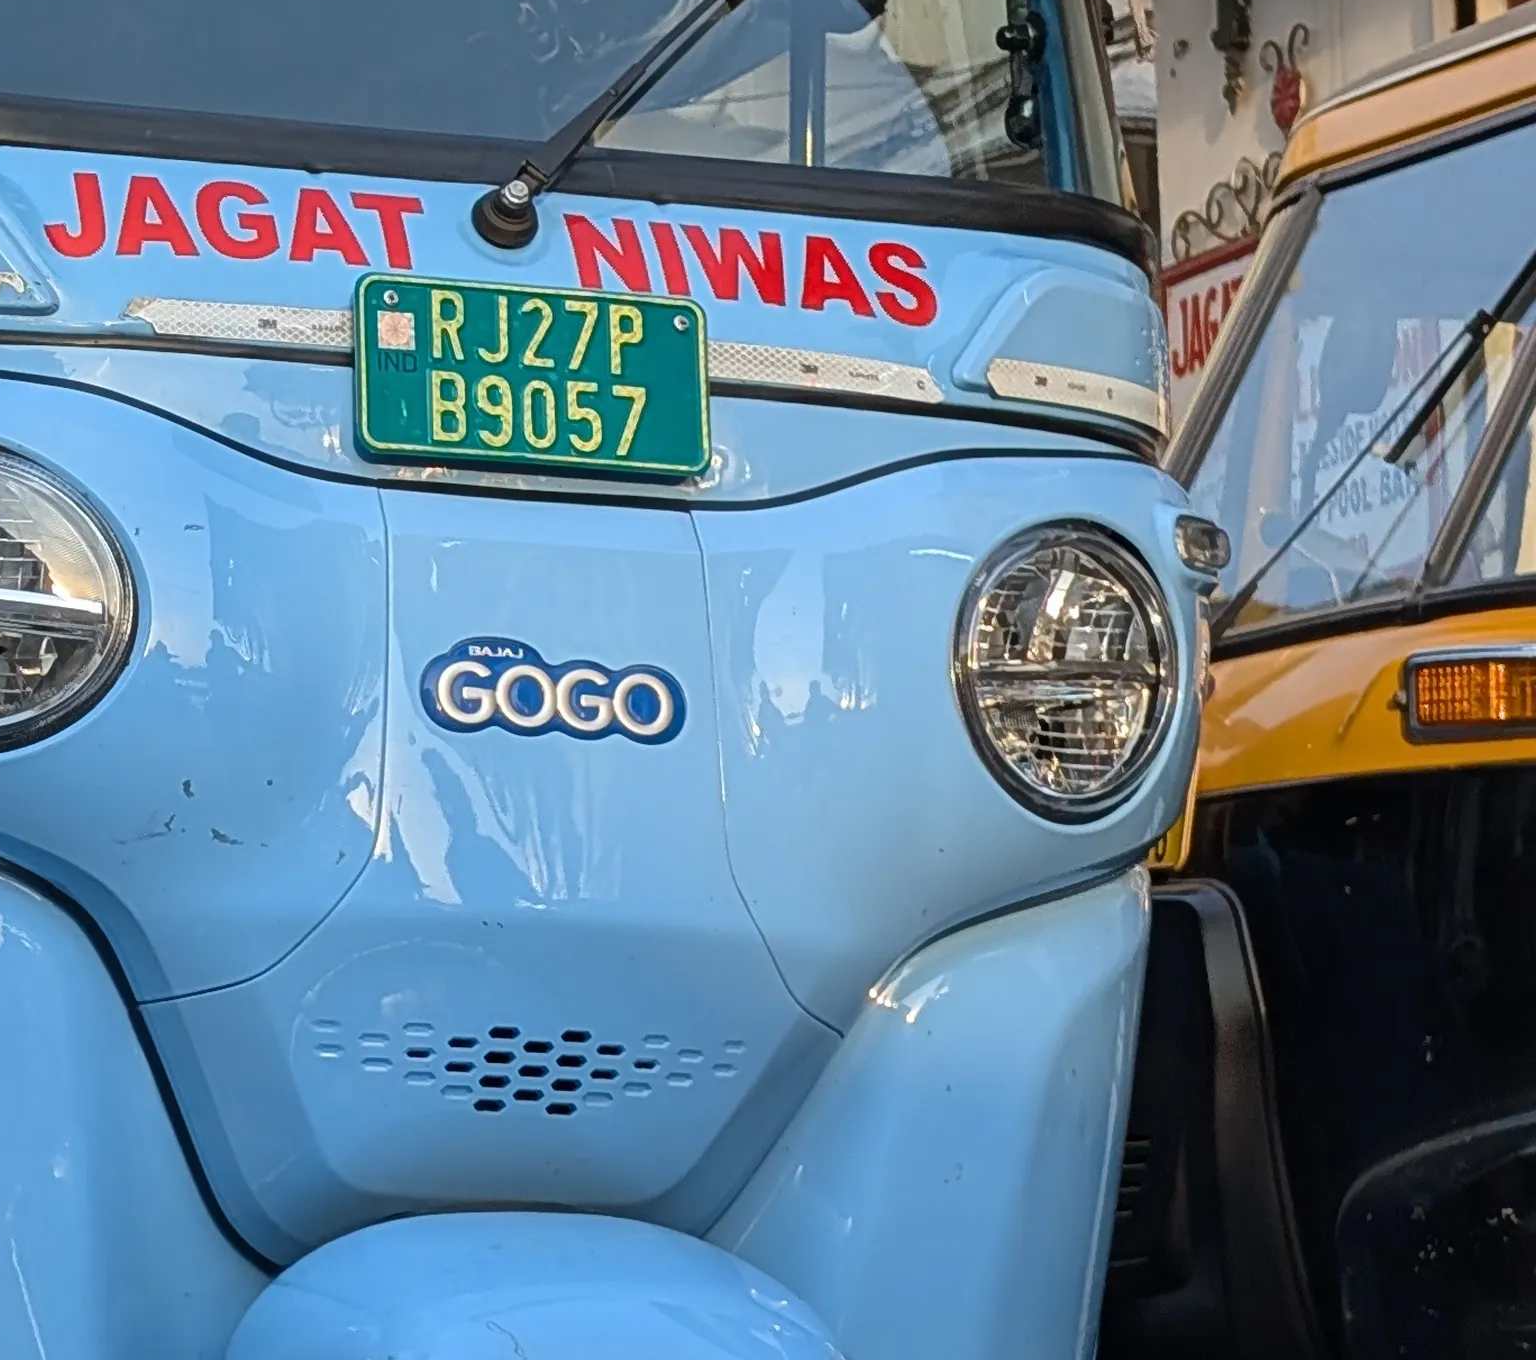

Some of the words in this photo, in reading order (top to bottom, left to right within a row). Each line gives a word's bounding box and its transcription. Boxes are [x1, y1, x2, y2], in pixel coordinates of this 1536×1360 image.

[43, 171, 424, 271] JAGAT
[563, 212, 938, 328] NIWAS
[258, 318, 278, 329] 3M
[430, 290, 644, 376] RJ27P
[376, 352, 419, 373] IND
[430, 369, 647, 456] B9057
[468, 645, 524, 659] BAJAJ
[437, 661, 673, 735] GOGO
